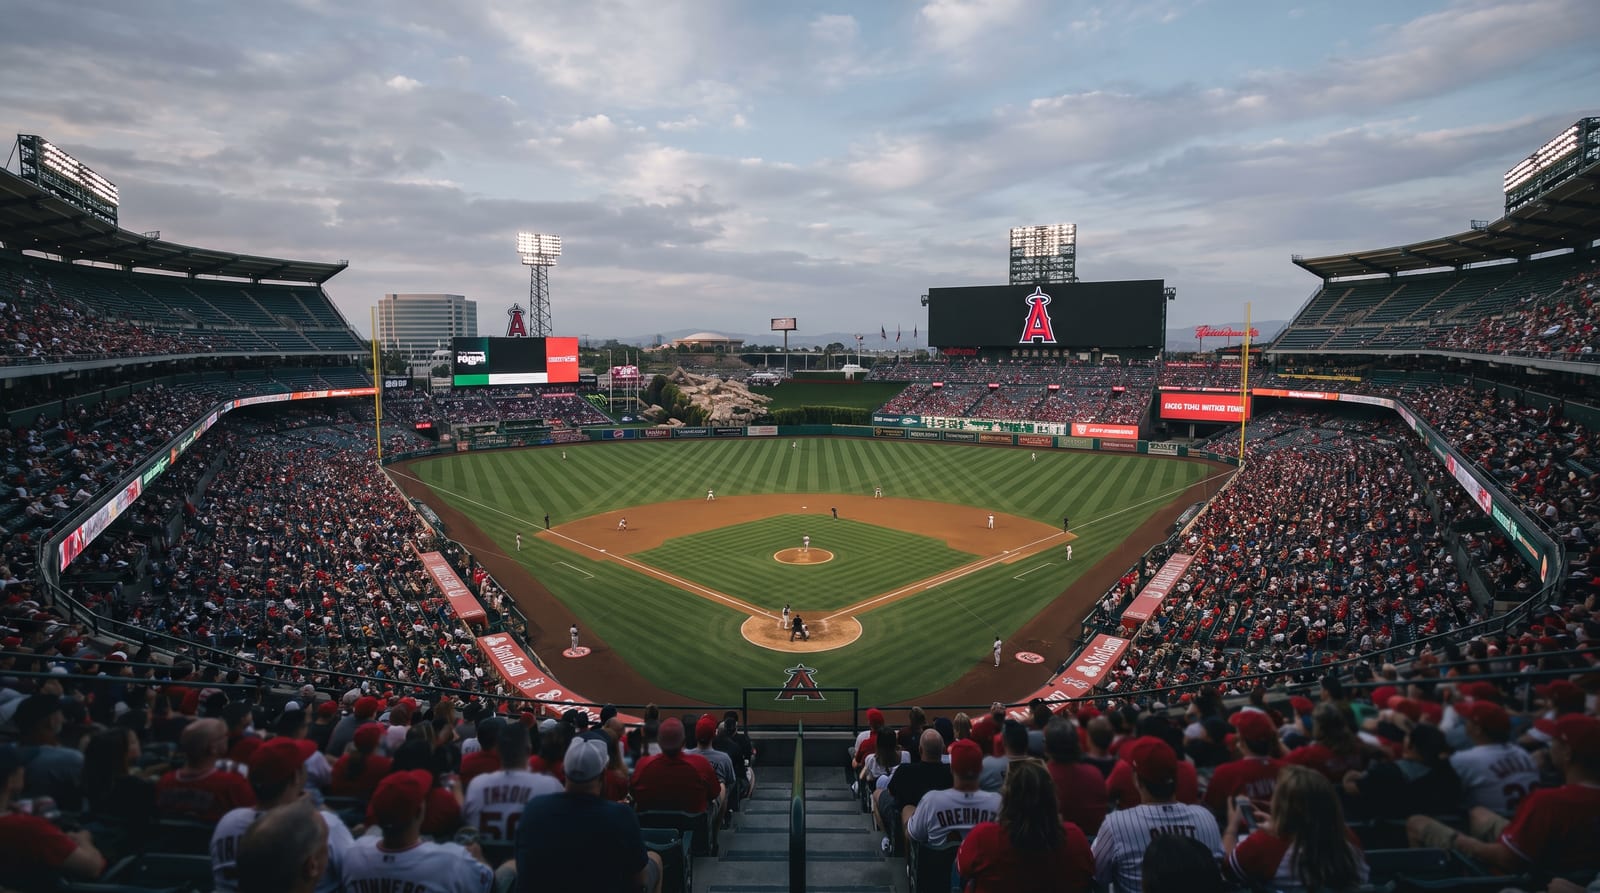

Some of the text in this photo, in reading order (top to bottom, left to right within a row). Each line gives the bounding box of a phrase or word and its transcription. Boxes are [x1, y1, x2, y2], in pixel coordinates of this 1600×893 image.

[504, 303, 529, 338] A
[1018, 286, 1058, 344] A
[773, 663, 828, 702] A
